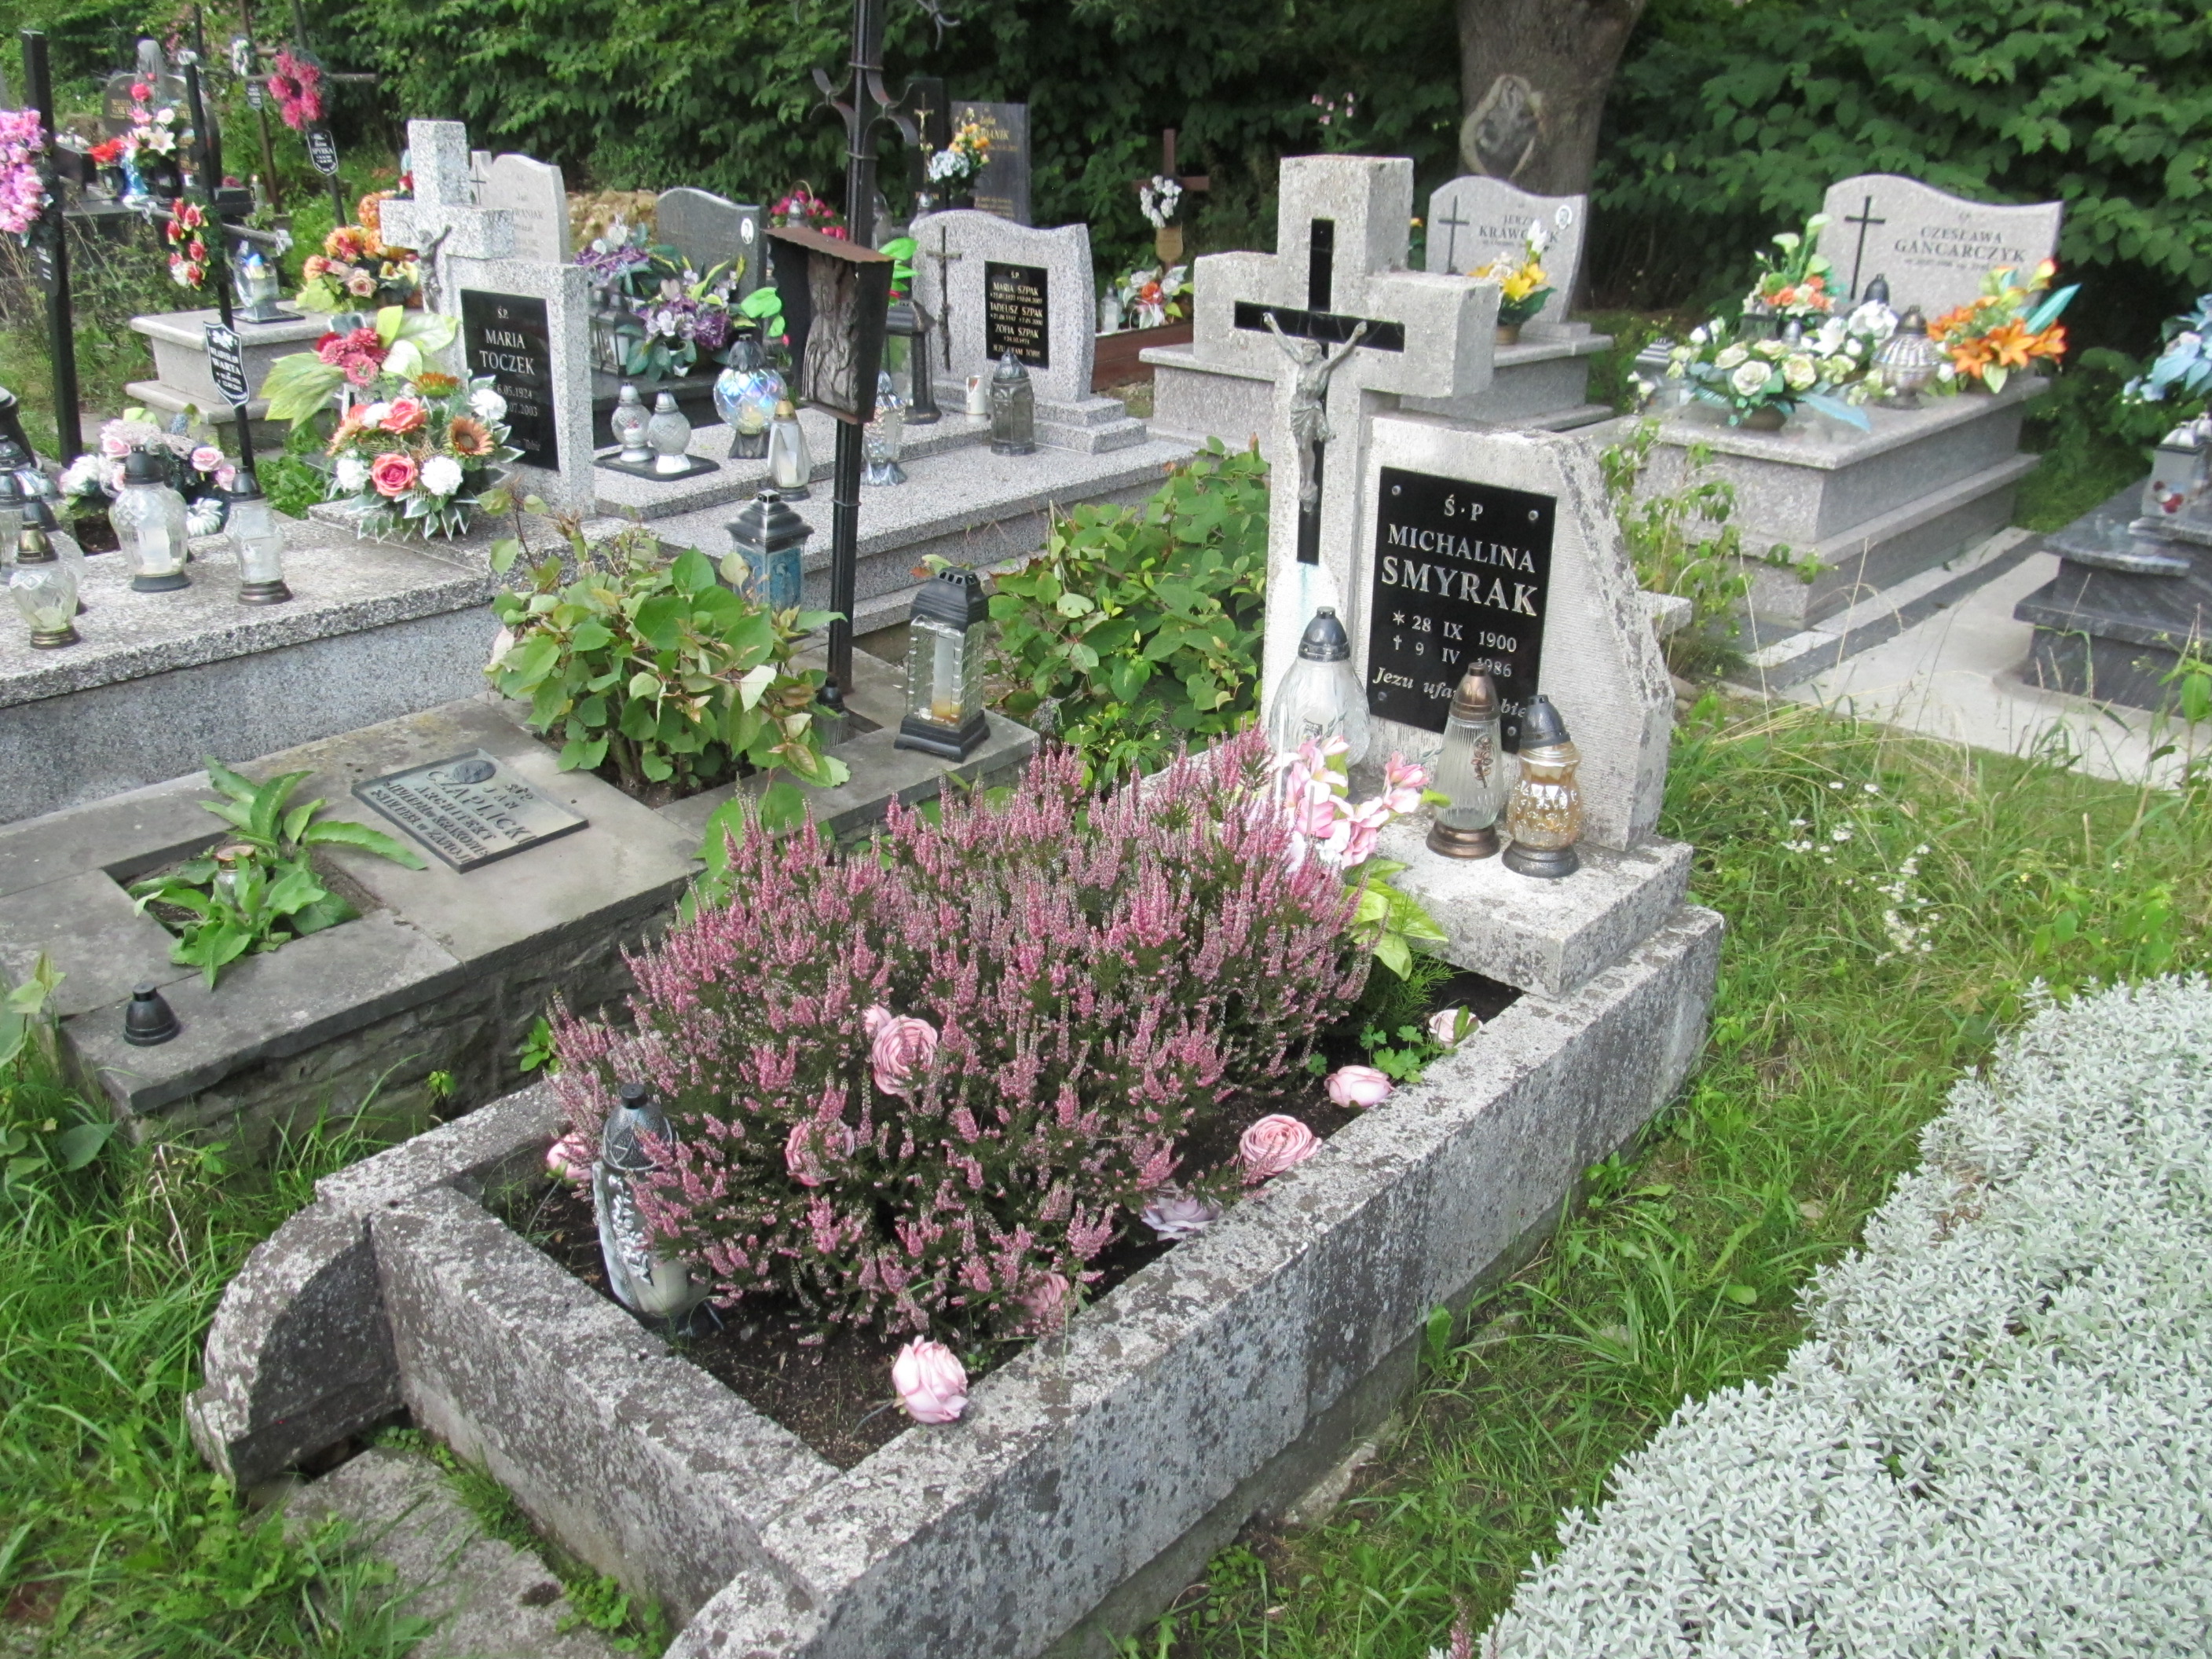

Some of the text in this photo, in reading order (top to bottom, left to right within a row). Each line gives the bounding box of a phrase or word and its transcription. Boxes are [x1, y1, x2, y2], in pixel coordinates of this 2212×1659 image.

[1479, 225, 1558, 243] KRAWCK
[1921, 226, 2002, 244] CZESŁAWA
[1894, 238, 2026, 262] GANCARCZYK
[993, 282, 1038, 297] MARIA SZPAK
[990, 302, 1043, 318] TADEUSZ SZPAK
[485, 329, 526, 349] MARIA
[994, 324, 1039, 339] ZOFIA SZPAK
[211, 357, 241, 375] WARTA
[479, 350, 536, 375] TOCZEK
[1388, 523, 1536, 573] MICHALINA
[1381, 555, 1539, 617] SMYRAK
[1412, 615, 1517, 653] 28 IX 1900
[1415, 642, 1424, 656] 9
[1442, 648, 1460, 665] IV
[1372, 667, 1414, 689] Jezu
[1423, 679, 1456, 701] ufa
[426, 771, 539, 844] CZAPLICKI
[482, 786, 521, 811] JAN
[414, 786, 497, 841] ARCHITEKT
